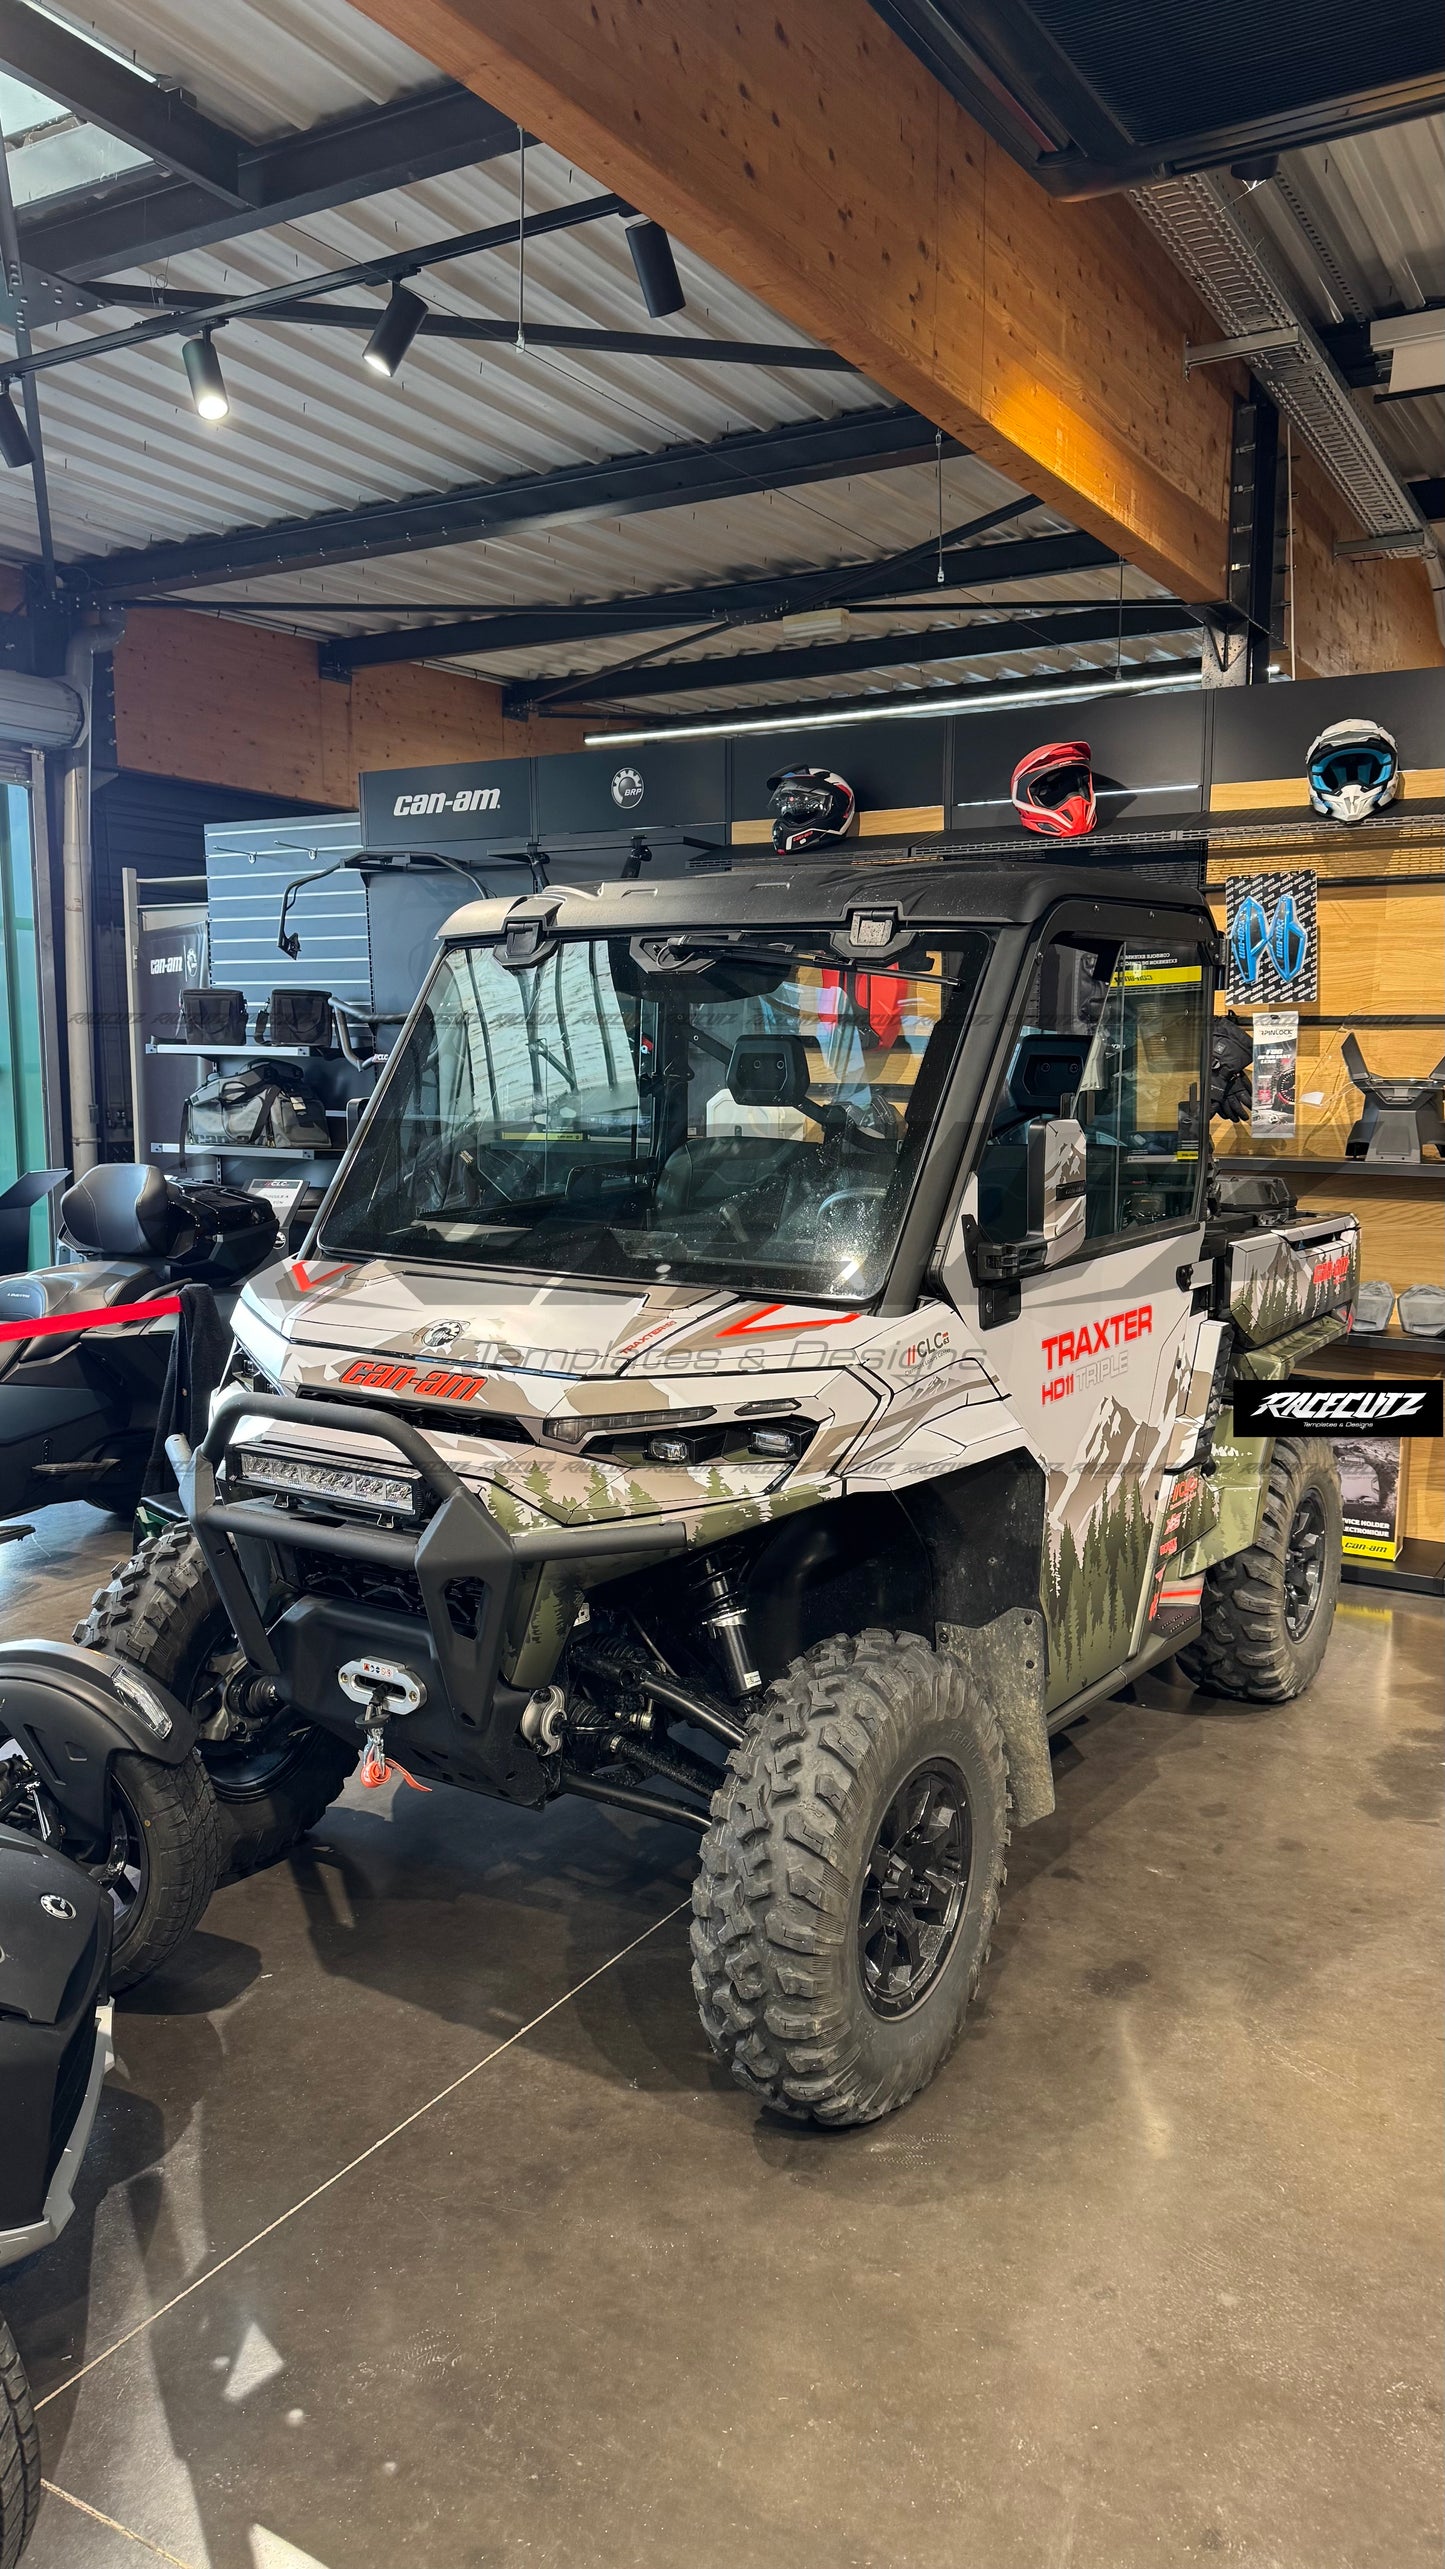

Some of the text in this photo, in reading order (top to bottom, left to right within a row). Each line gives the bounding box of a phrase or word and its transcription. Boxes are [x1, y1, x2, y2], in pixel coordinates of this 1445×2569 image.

[393, 788, 501, 816] can-am
[624, 788, 642, 797] BRP
[150, 956, 183, 975] can-am
[1041, 1304, 1153, 1371] TRAXTER
[339, 1360, 488, 1401] can-am
[1041, 1350, 1128, 1406] HD11 TRIPLE
[1361, 1520, 1390, 1529] HOLDER
[1345, 1542, 1388, 1553] can-am
